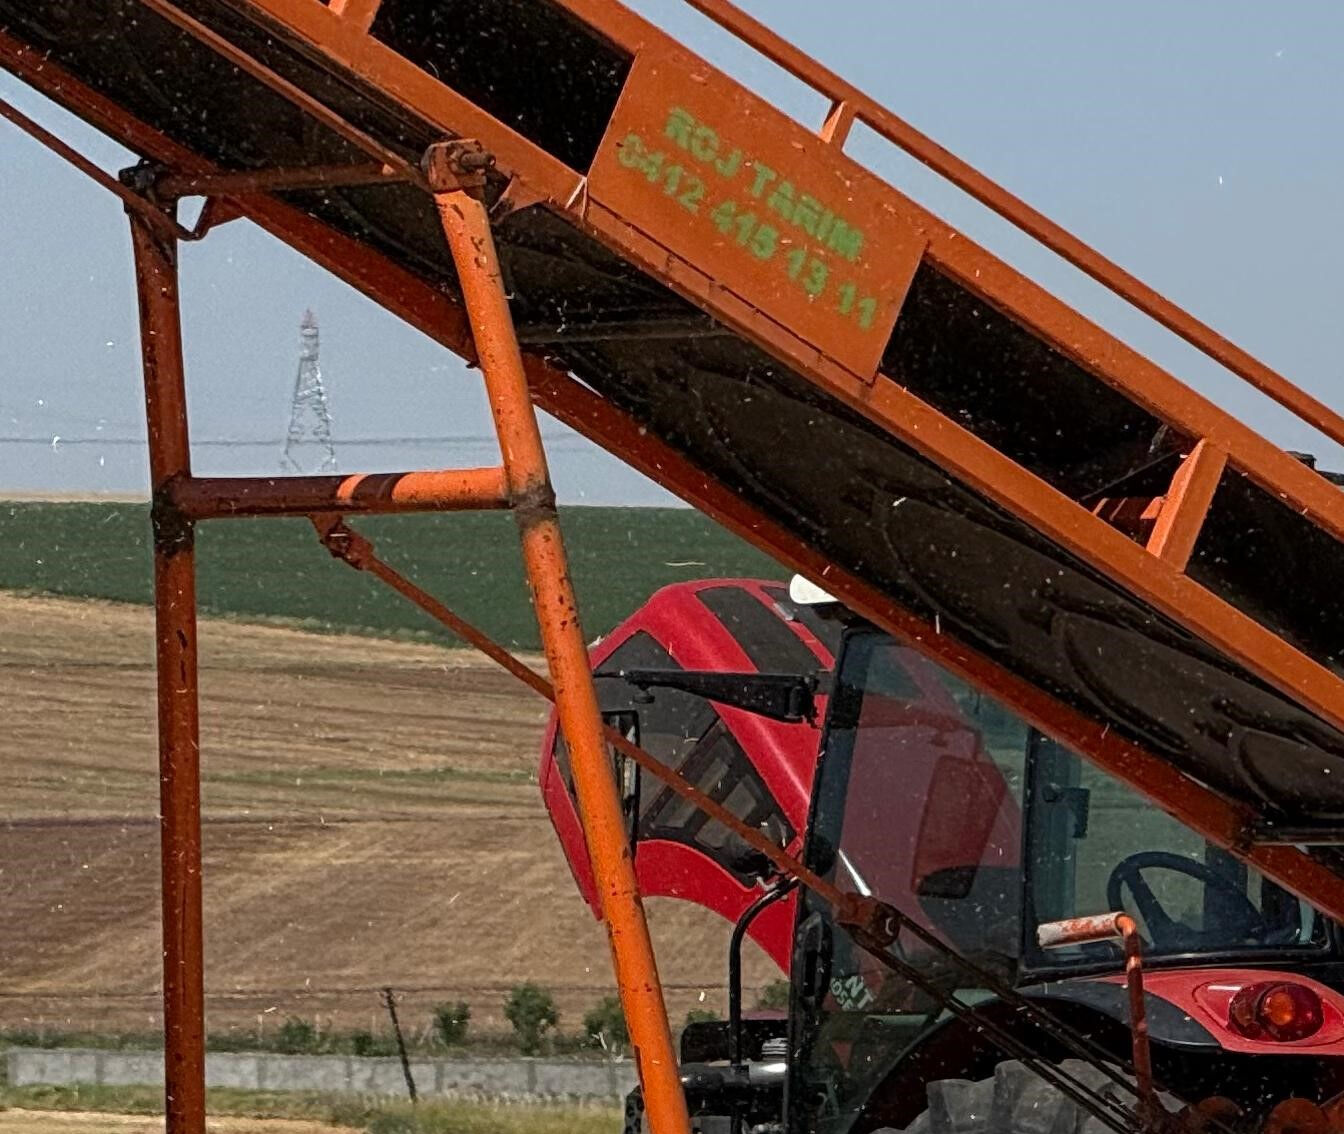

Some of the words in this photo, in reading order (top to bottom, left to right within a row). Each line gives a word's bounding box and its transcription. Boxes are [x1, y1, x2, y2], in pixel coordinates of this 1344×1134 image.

[618, 132, 706, 214] 0412
[787, 249, 829, 296] 13
[838, 282, 878, 330] 11
[665, 106, 743, 179] ROJ
[751, 160, 864, 260] TARIM
